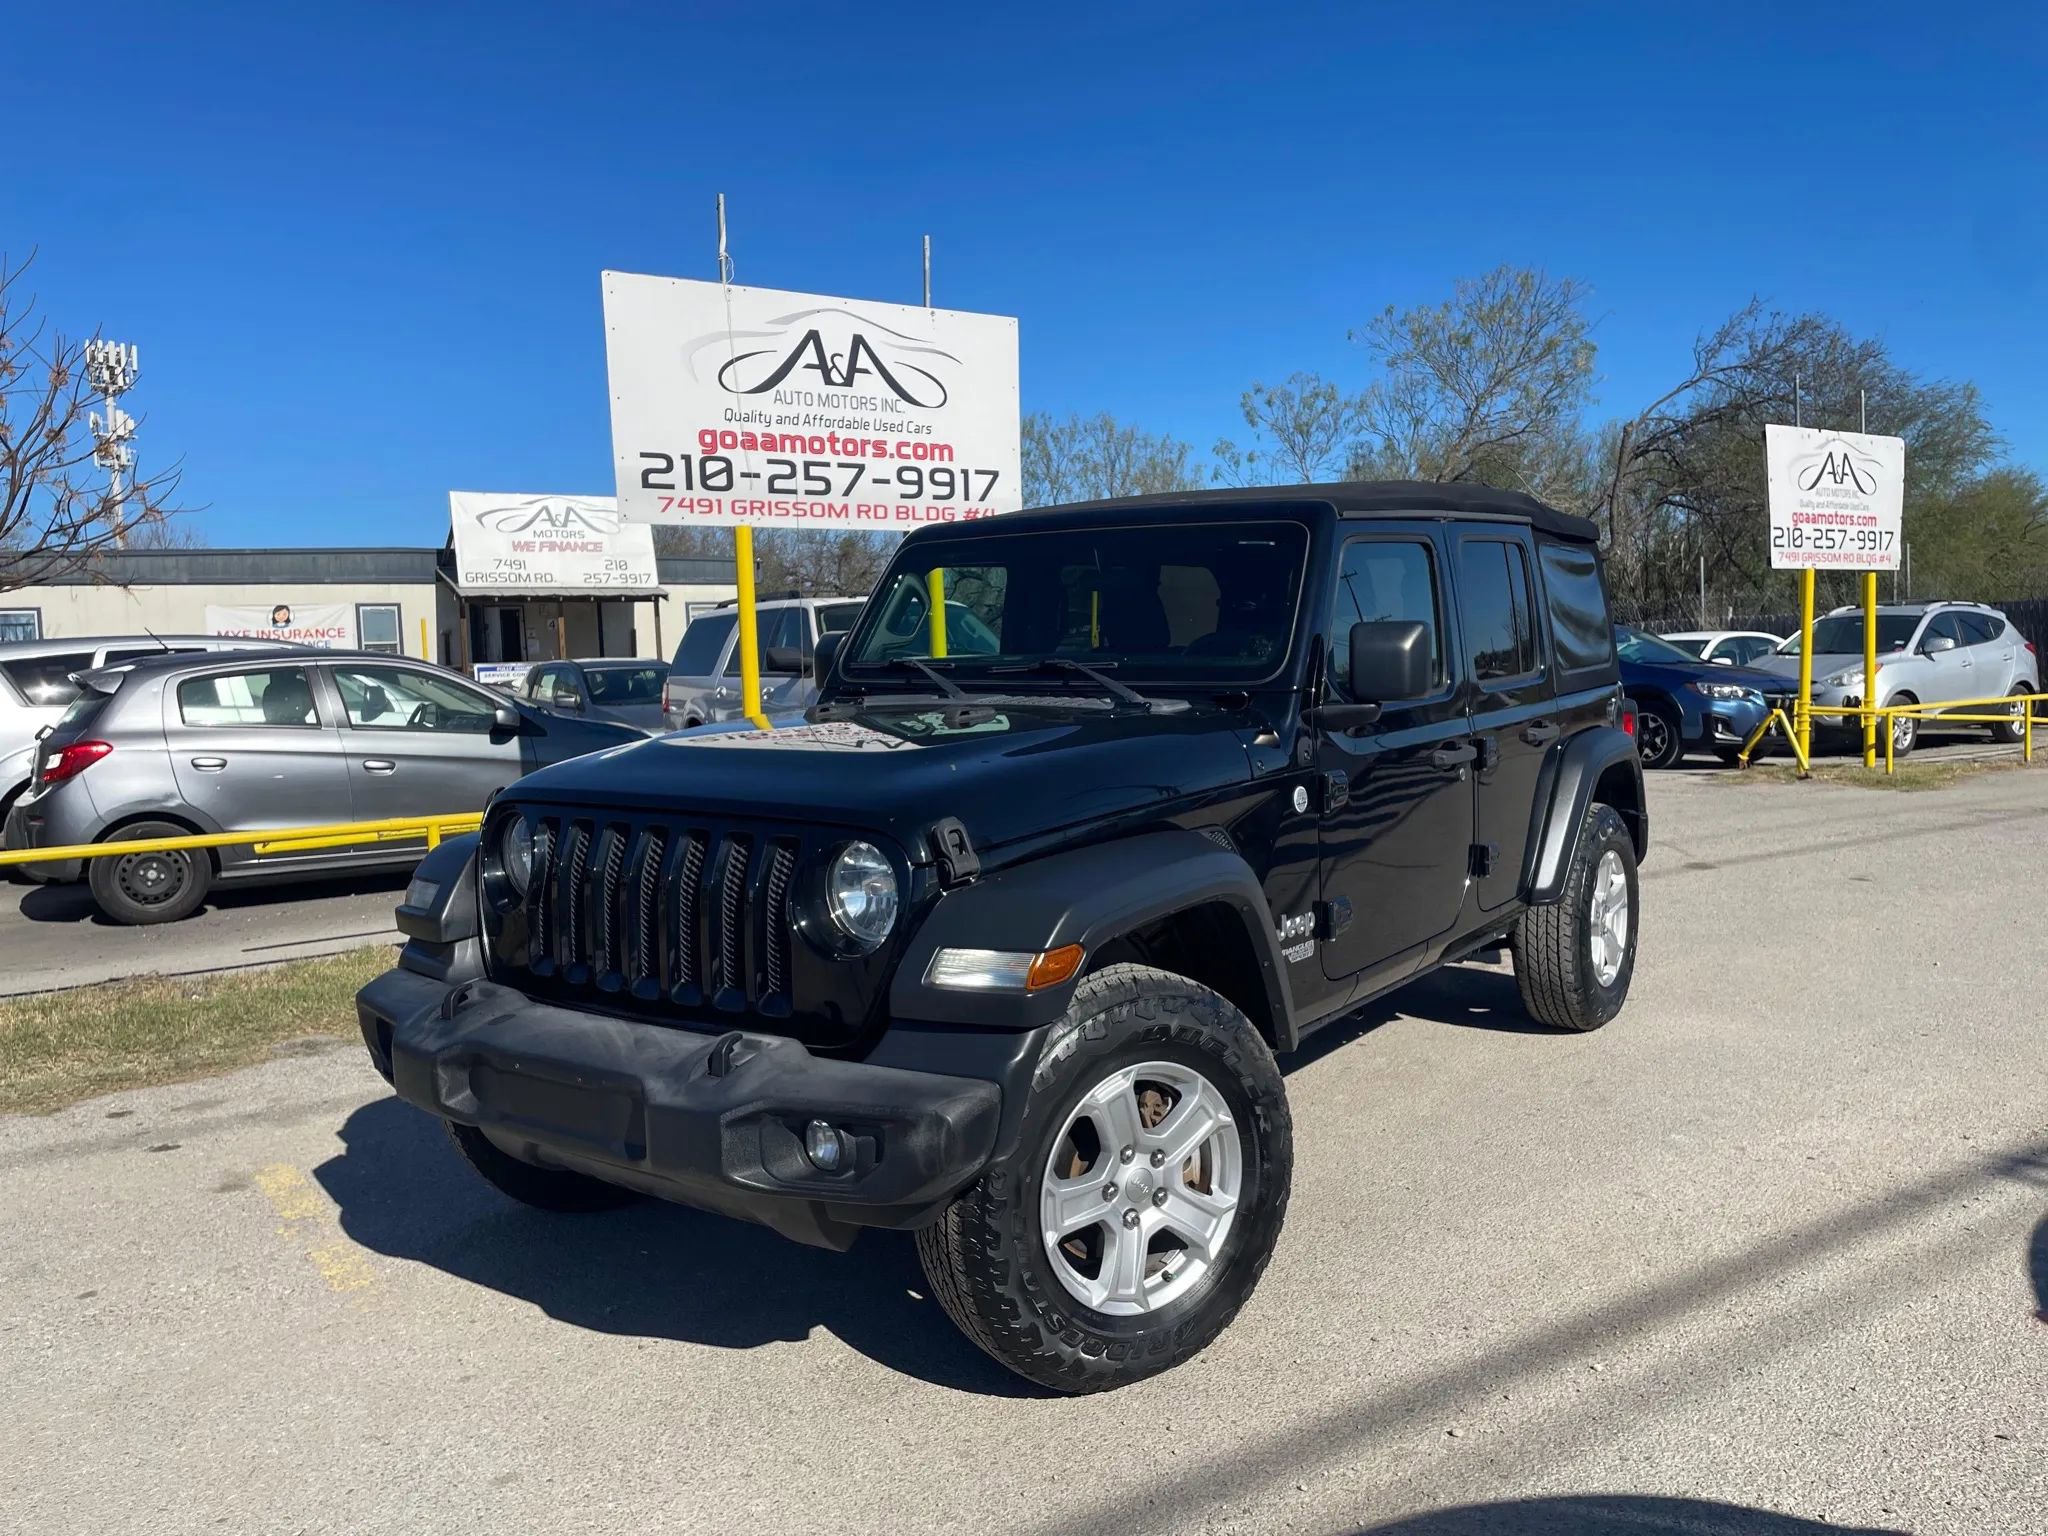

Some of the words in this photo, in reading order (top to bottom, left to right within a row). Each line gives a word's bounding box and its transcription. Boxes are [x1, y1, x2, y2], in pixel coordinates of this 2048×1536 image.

[773, 389, 814, 407] AUTO
[817, 391, 878, 411] MOTORS
[881, 396, 906, 414] INC.
[724, 407, 772, 428] Quality
[775, 411, 799, 427] and
[802, 411, 871, 432] Affordable
[873, 417, 904, 433] Used
[906, 420, 932, 435] Cars
[698, 427, 954, 462] goaamotors.com
[639, 451, 1000, 502] 210-257-9917
[656, 496, 723, 515] 7491
[731, 499, 850, 520] GRISSOM
[856, 503, 889, 520] RD
[895, 505, 956, 522] BLDG
[1792, 511, 1877, 528] goaamotors.com
[533, 529, 585, 539] MOTORS
[1773, 526, 1894, 551] 210-257-9917
[512, 541, 536, 552] WE
[538, 541, 603, 553] FINANCE
[493, 558, 527, 570] 7491
[604, 559, 628, 570] 210
[1778, 551, 1801, 562] 7491
[1801, 552, 1843, 563] GRISSOM
[465, 572, 531, 583] GRISSOM
[583, 573, 651, 584] 257-9917
[256, 627, 346, 641] INSURANCE
[1276, 911, 1316, 942] Jeep
